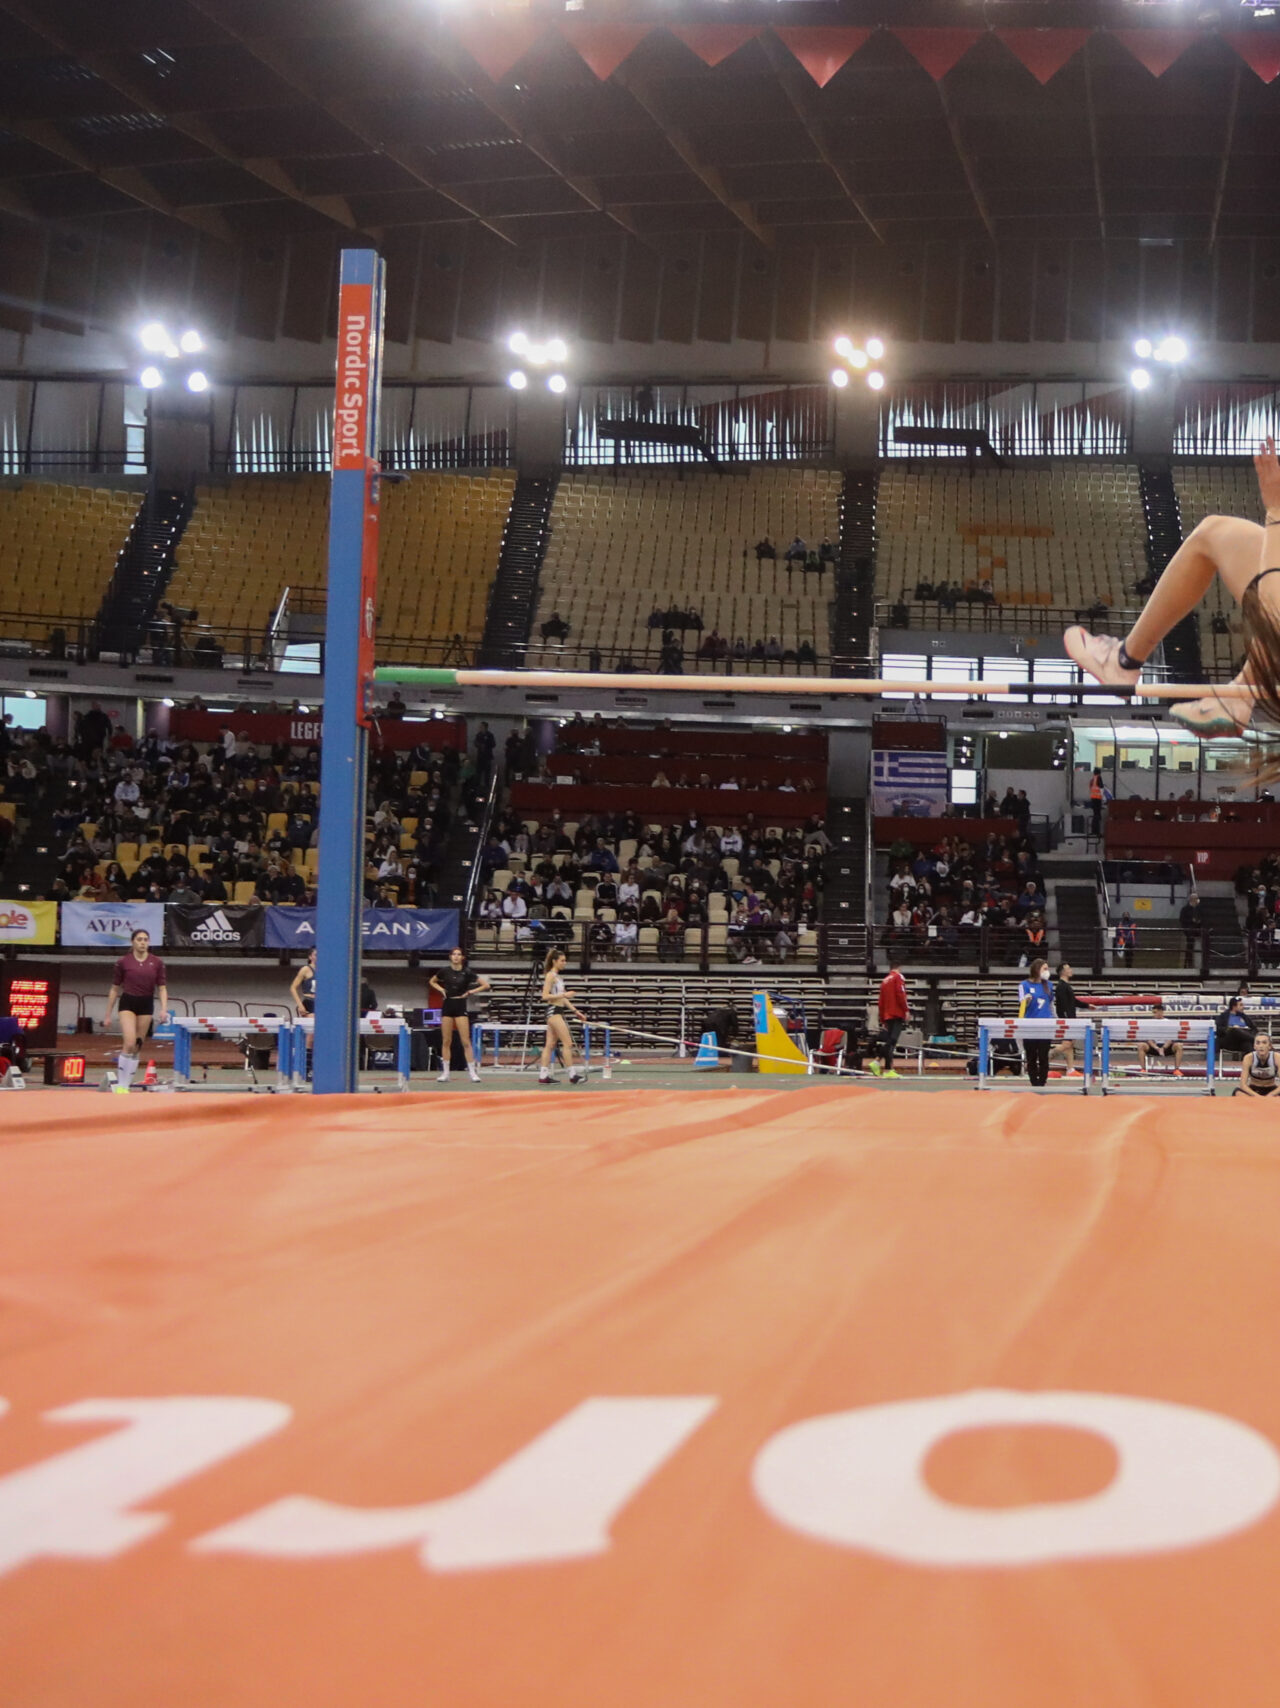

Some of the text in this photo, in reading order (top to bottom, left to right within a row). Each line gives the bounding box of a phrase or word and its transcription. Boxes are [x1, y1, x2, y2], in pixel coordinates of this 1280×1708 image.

[344, 315, 366, 389] nordic
[190, 928, 241, 941] adidas
[295, 921, 411, 936] AEAN
